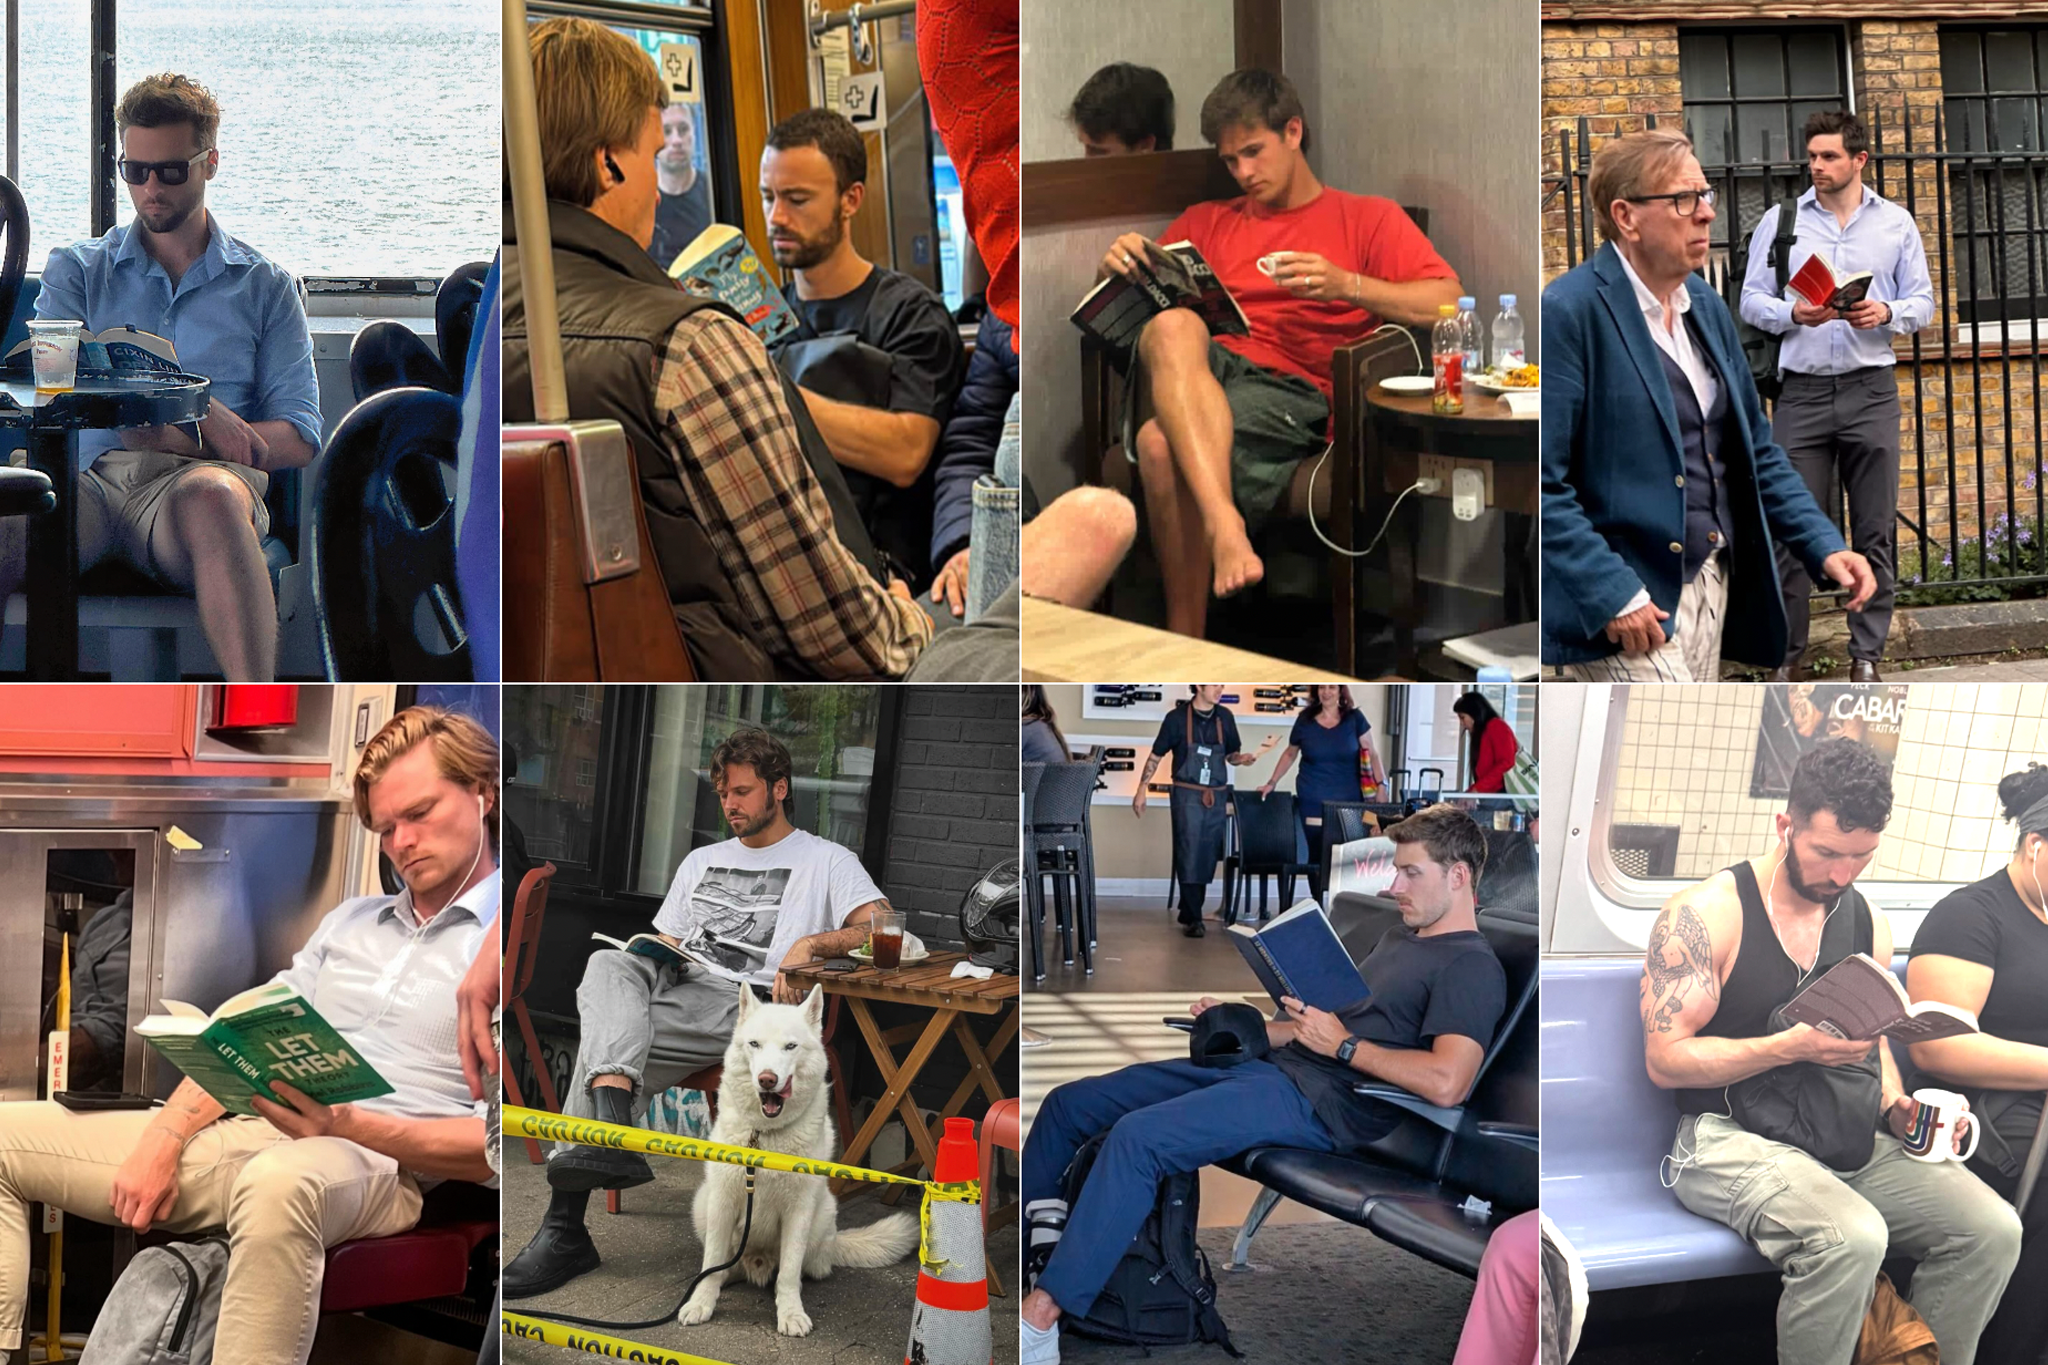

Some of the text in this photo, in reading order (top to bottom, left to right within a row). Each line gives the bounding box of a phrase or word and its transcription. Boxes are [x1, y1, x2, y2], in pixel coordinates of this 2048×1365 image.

[114, 347, 154, 364] CIXIN
[1875, 723, 1889, 734] KIT
[1353, 847, 1398, 879] Welc
[267, 1026, 292, 1037] THE
[264, 1032, 320, 1060] LET
[217, 1042, 238, 1059] LET
[233, 1055, 261, 1080] THEM
[267, 1048, 360, 1080] THEM
[306, 1070, 351, 1085] THEORY
